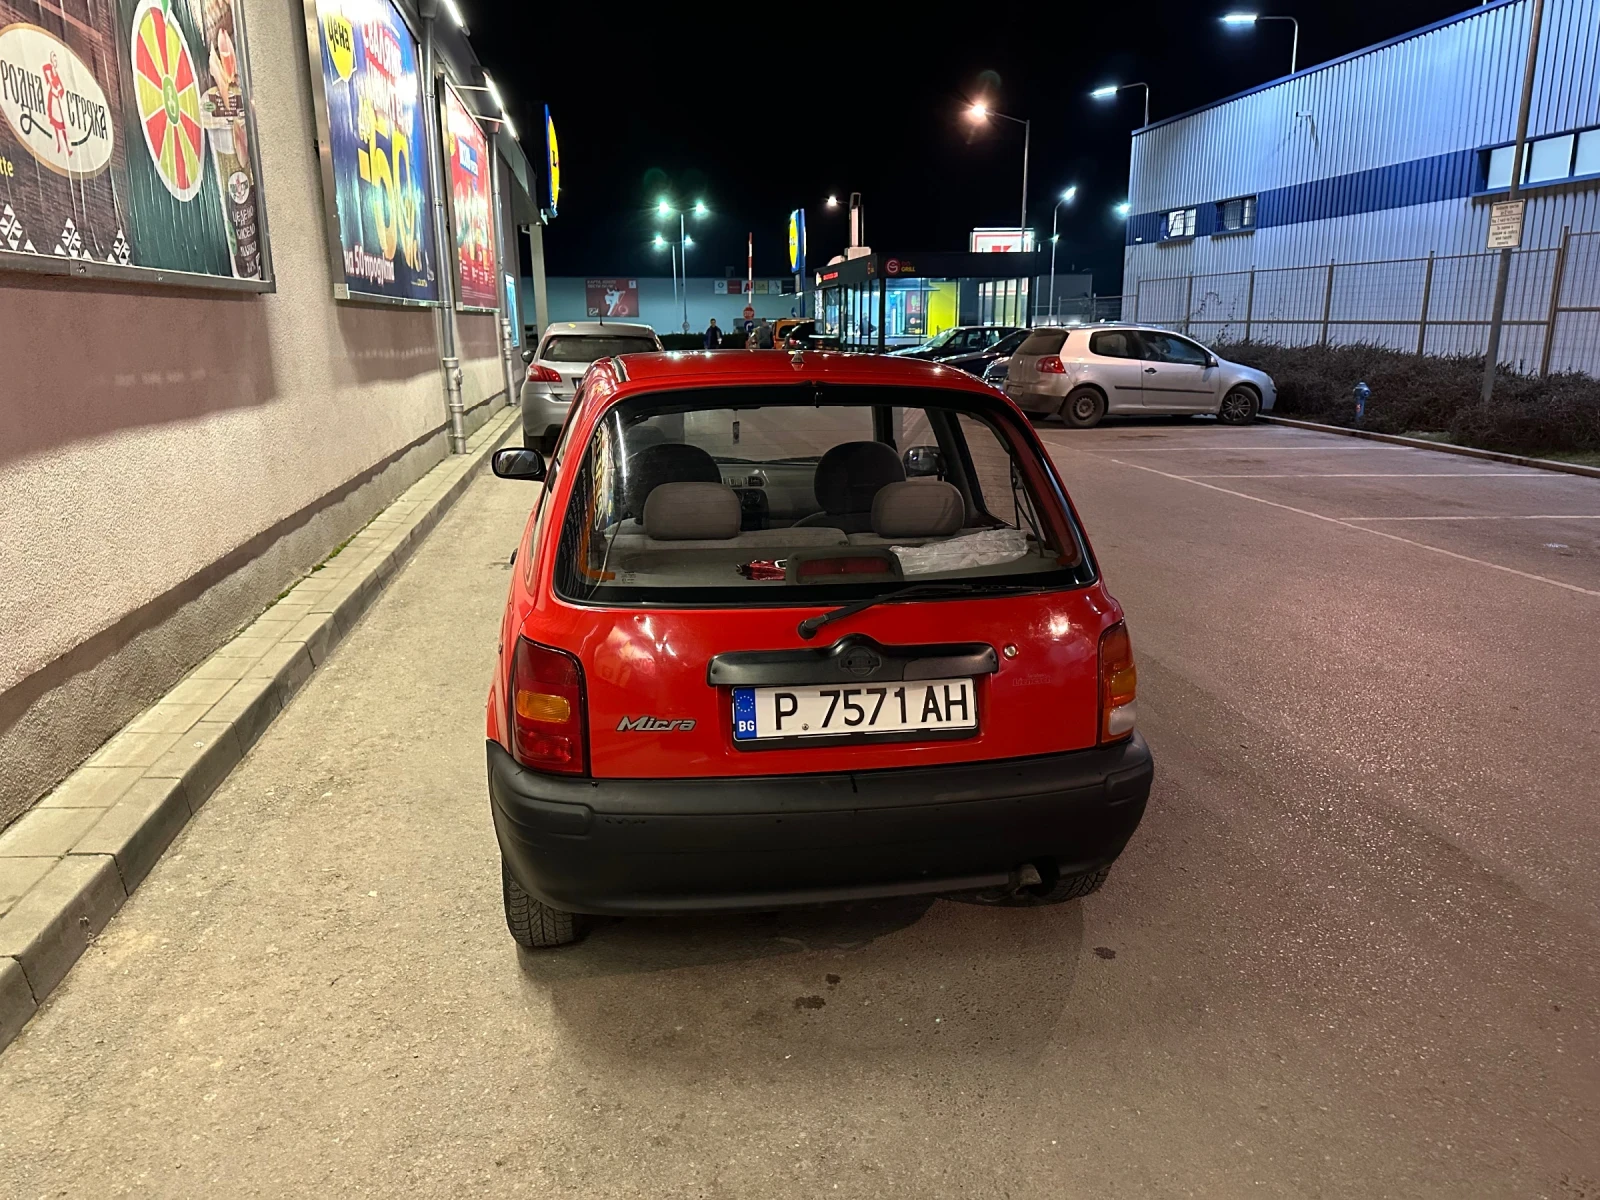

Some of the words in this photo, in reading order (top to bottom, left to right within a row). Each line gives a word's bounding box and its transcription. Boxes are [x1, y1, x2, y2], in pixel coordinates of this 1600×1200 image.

[328, 17, 351, 53] цена
[354, 244, 364, 276] 50
[616, 715, 696, 732] Micra
[774, 692, 798, 731] P
[819, 687, 907, 728] 7571
[921, 684, 968, 723] AH
[738, 720, 755, 732] BG
